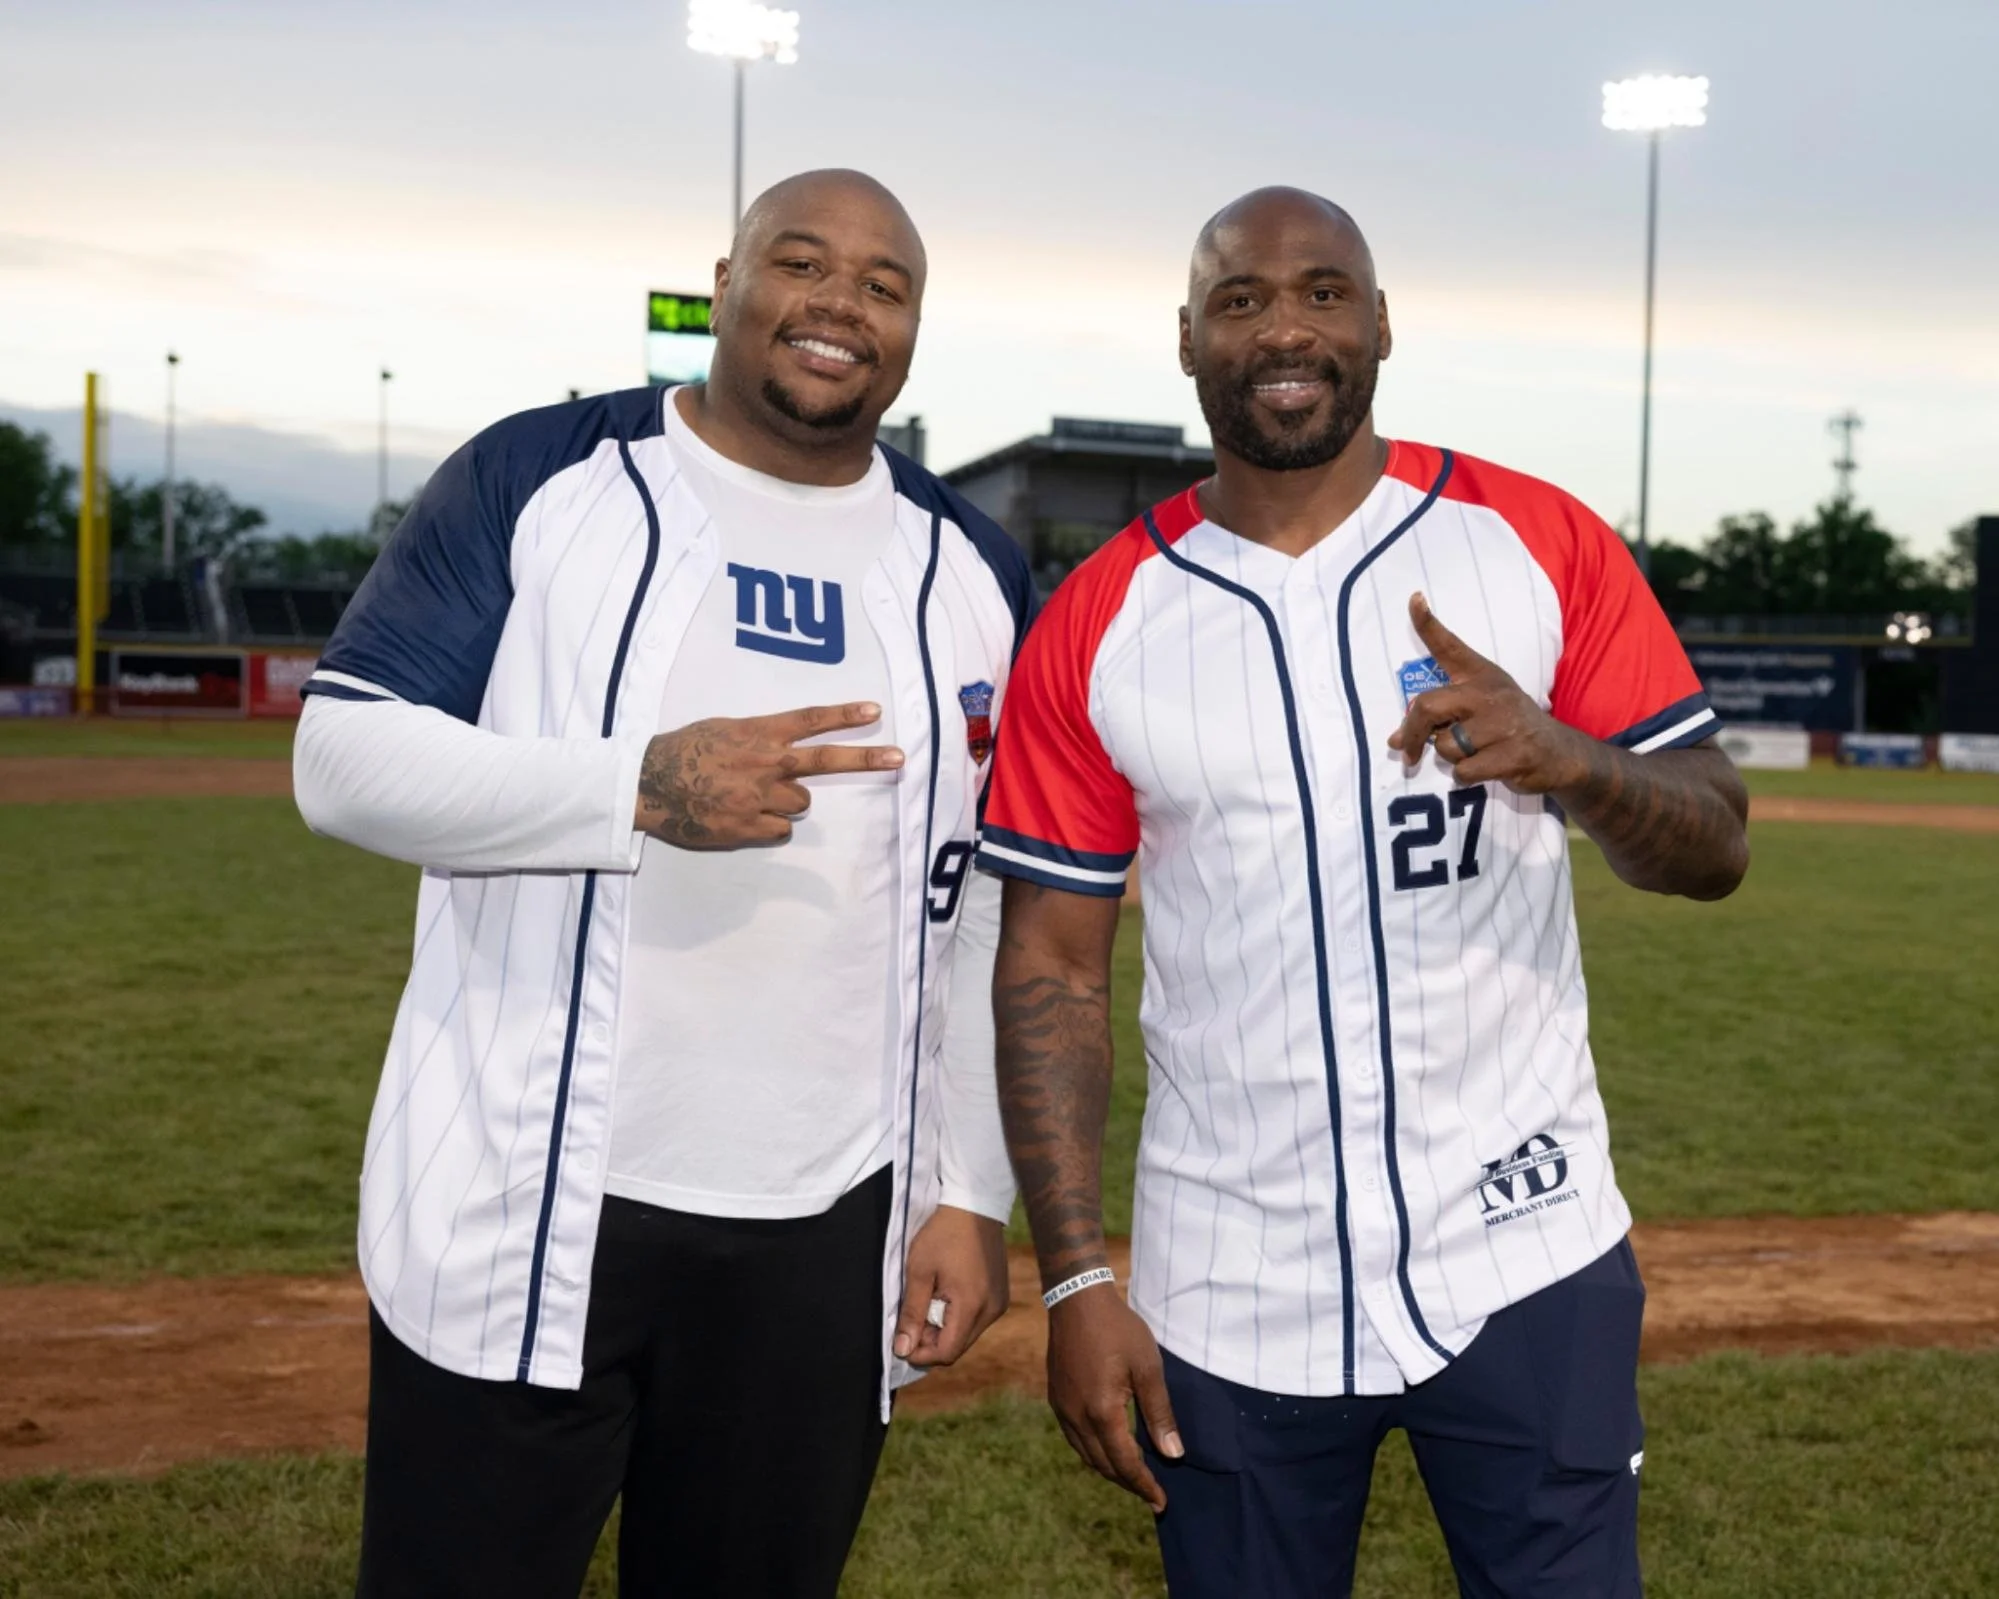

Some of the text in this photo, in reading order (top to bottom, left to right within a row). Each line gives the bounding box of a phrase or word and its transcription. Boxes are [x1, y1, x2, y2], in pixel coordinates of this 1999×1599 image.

[1388, 785, 1488, 891] 27
[926, 841, 973, 922] 9
[1485, 1189, 1580, 1228] MERCHANT DIRECT
[1059, 1280, 1079, 1296] HAS
